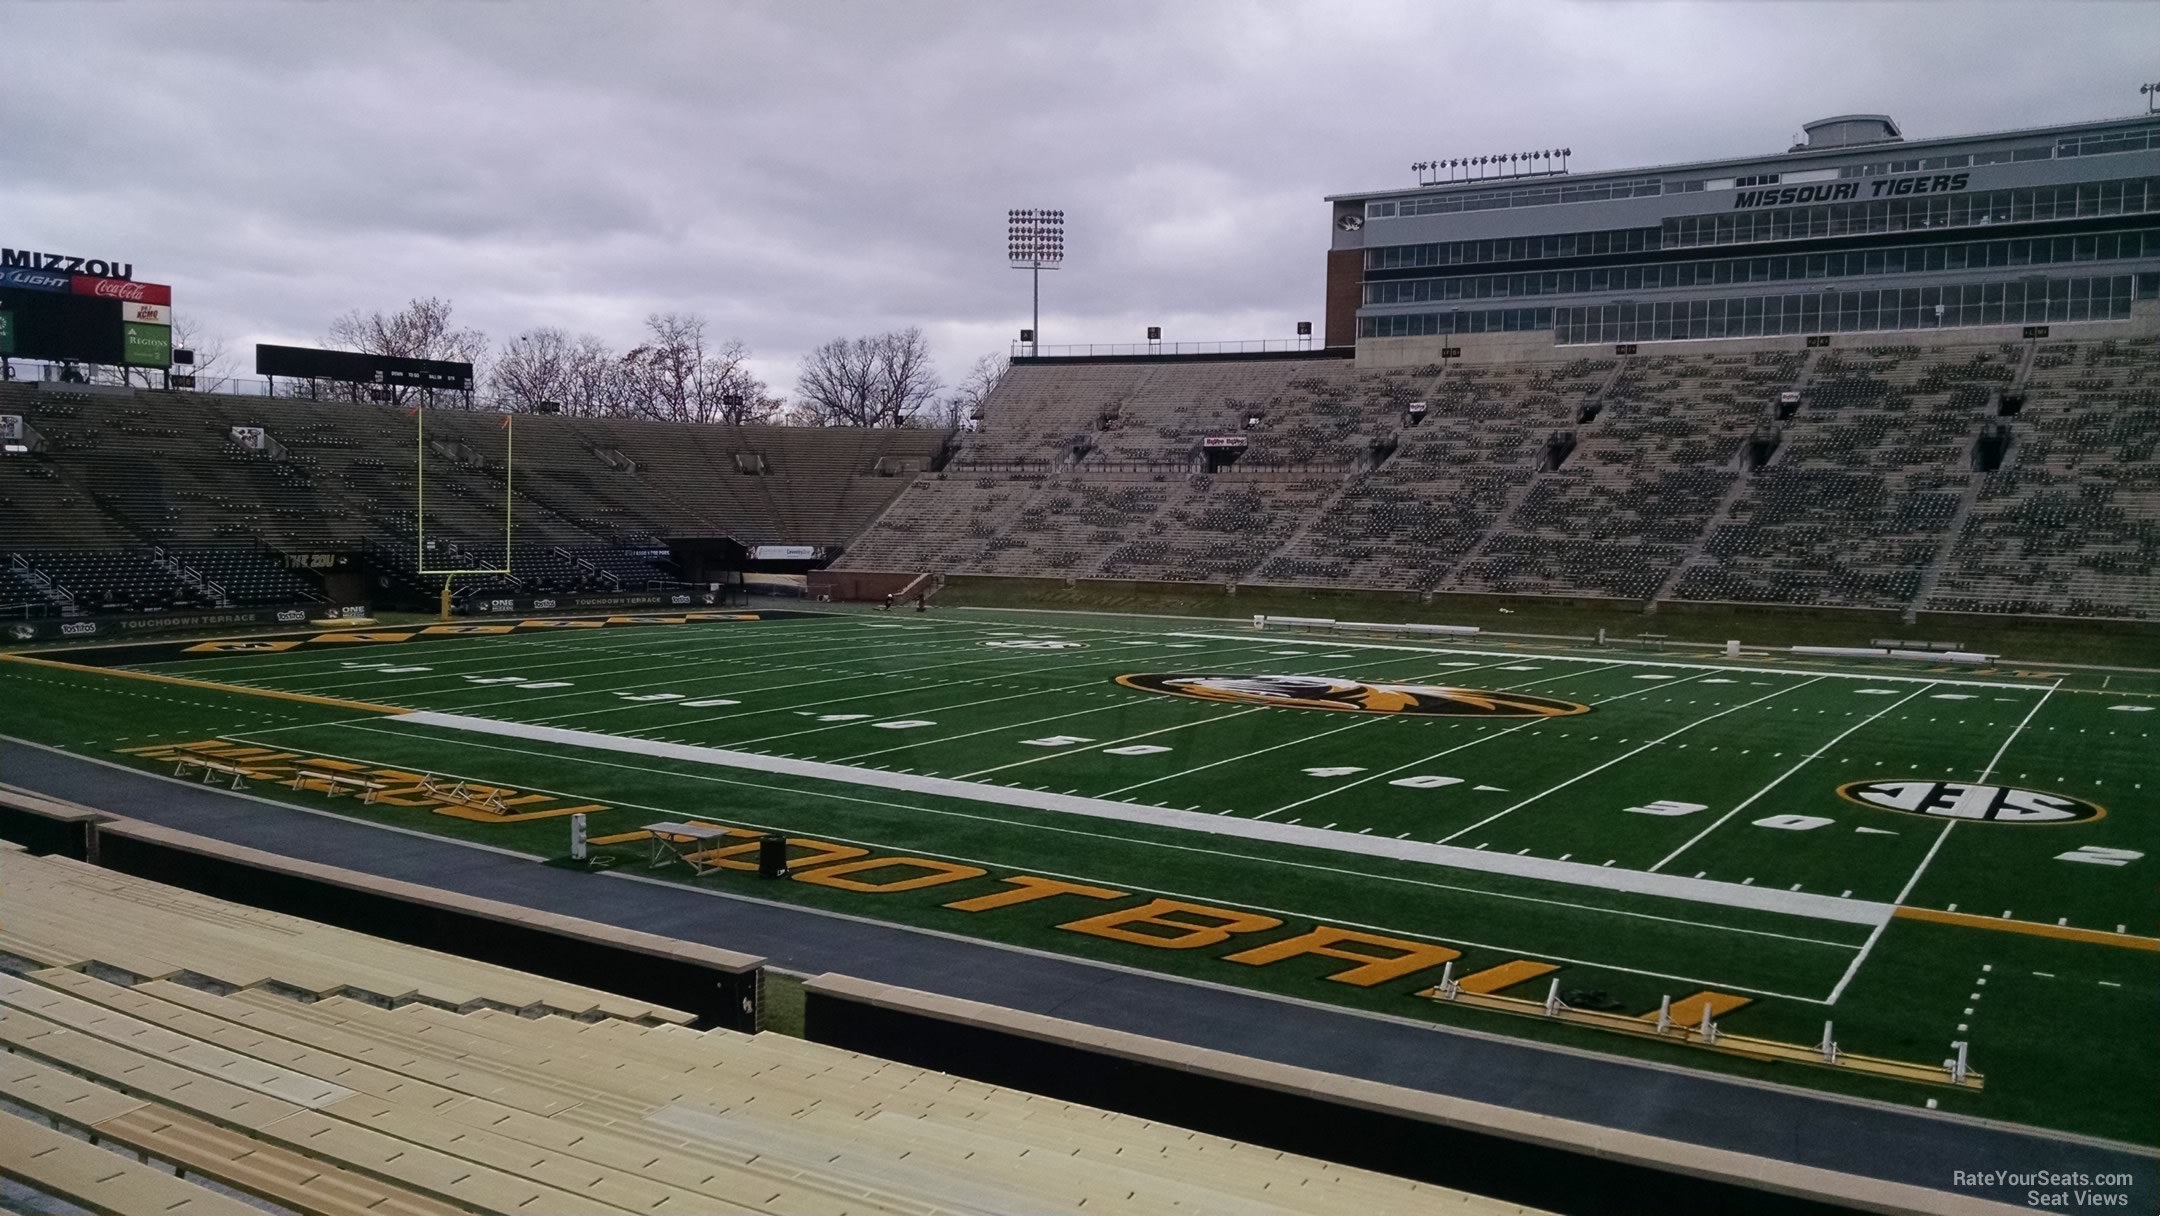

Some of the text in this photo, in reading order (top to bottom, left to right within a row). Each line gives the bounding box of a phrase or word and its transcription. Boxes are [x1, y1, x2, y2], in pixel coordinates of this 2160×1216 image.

[1734, 172, 1971, 209] MISSOURI TIGERS
[2, 248, 133, 281] MIZZOU
[13, 272, 69, 287] LIGHT
[310, 554, 336, 568] ZOU
[576, 598, 625, 606] TOUCHDOWN
[120, 614, 256, 629] TOUCHDOWN TERRACE
[1857, 782, 2078, 821] SEC
